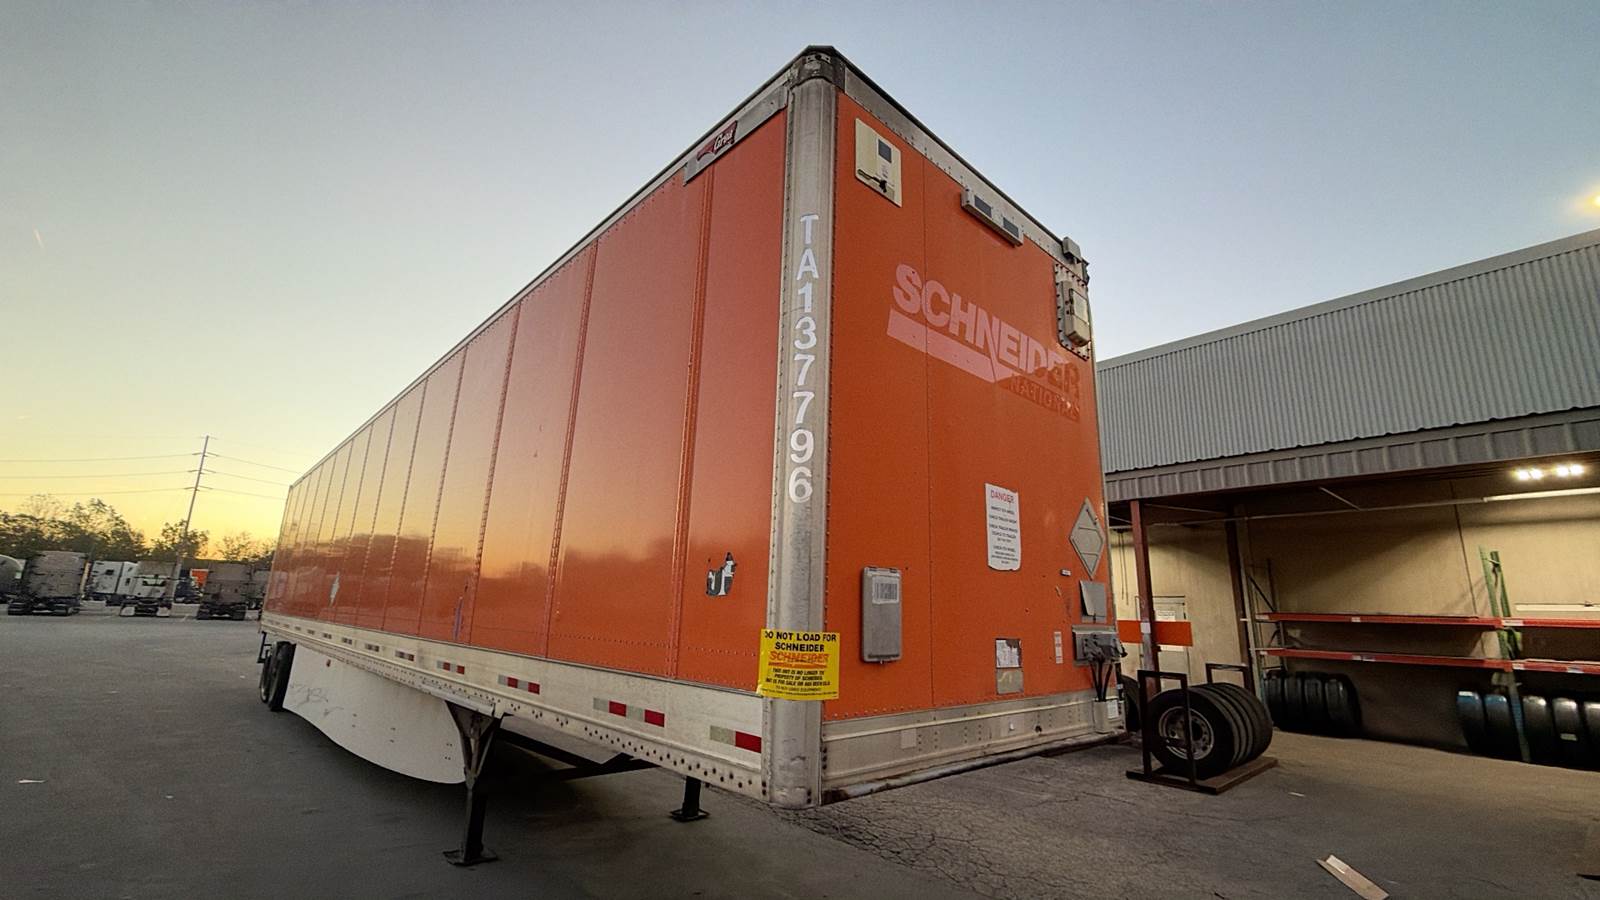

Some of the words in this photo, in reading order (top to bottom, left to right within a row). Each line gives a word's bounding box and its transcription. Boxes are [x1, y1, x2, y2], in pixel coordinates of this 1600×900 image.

[789, 213, 819, 503] TA137796
[893, 264, 1080, 397] SCHNEIDER
[775, 642, 825, 652] SCHNEIDER
[776, 632, 794, 640] NOT
[796, 633, 820, 641] LOAD
[822, 634, 837, 642] FOR
